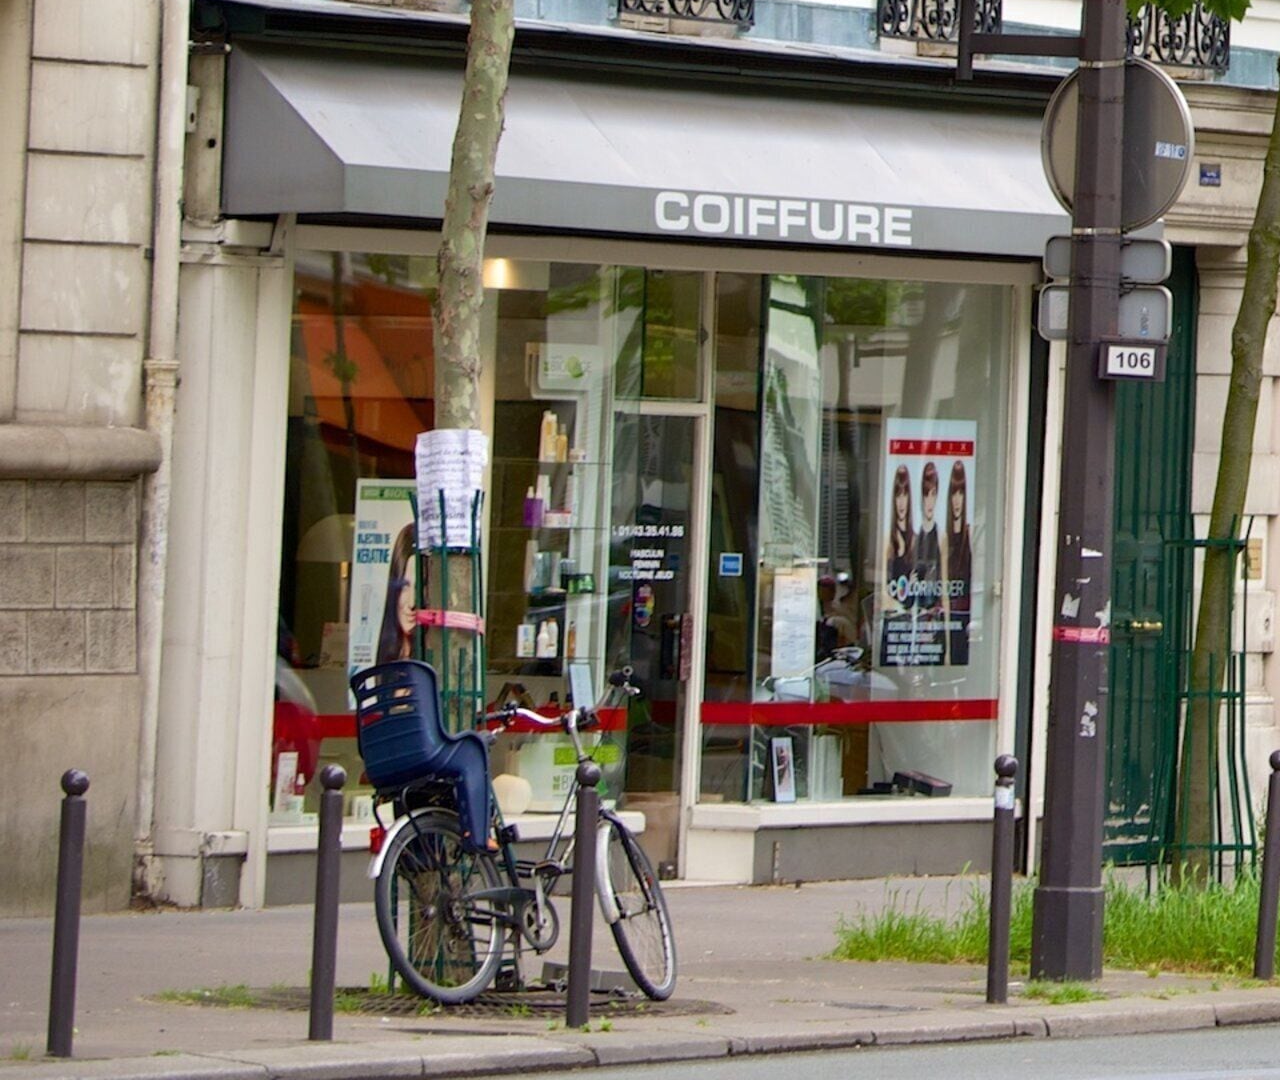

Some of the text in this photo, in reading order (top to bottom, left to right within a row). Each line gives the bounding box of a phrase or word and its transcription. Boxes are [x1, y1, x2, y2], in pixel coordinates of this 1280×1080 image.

[654, 191, 912, 246] COIFFURE
[1116, 352, 1151, 369] 106
[892, 441, 967, 451] MATRIX
